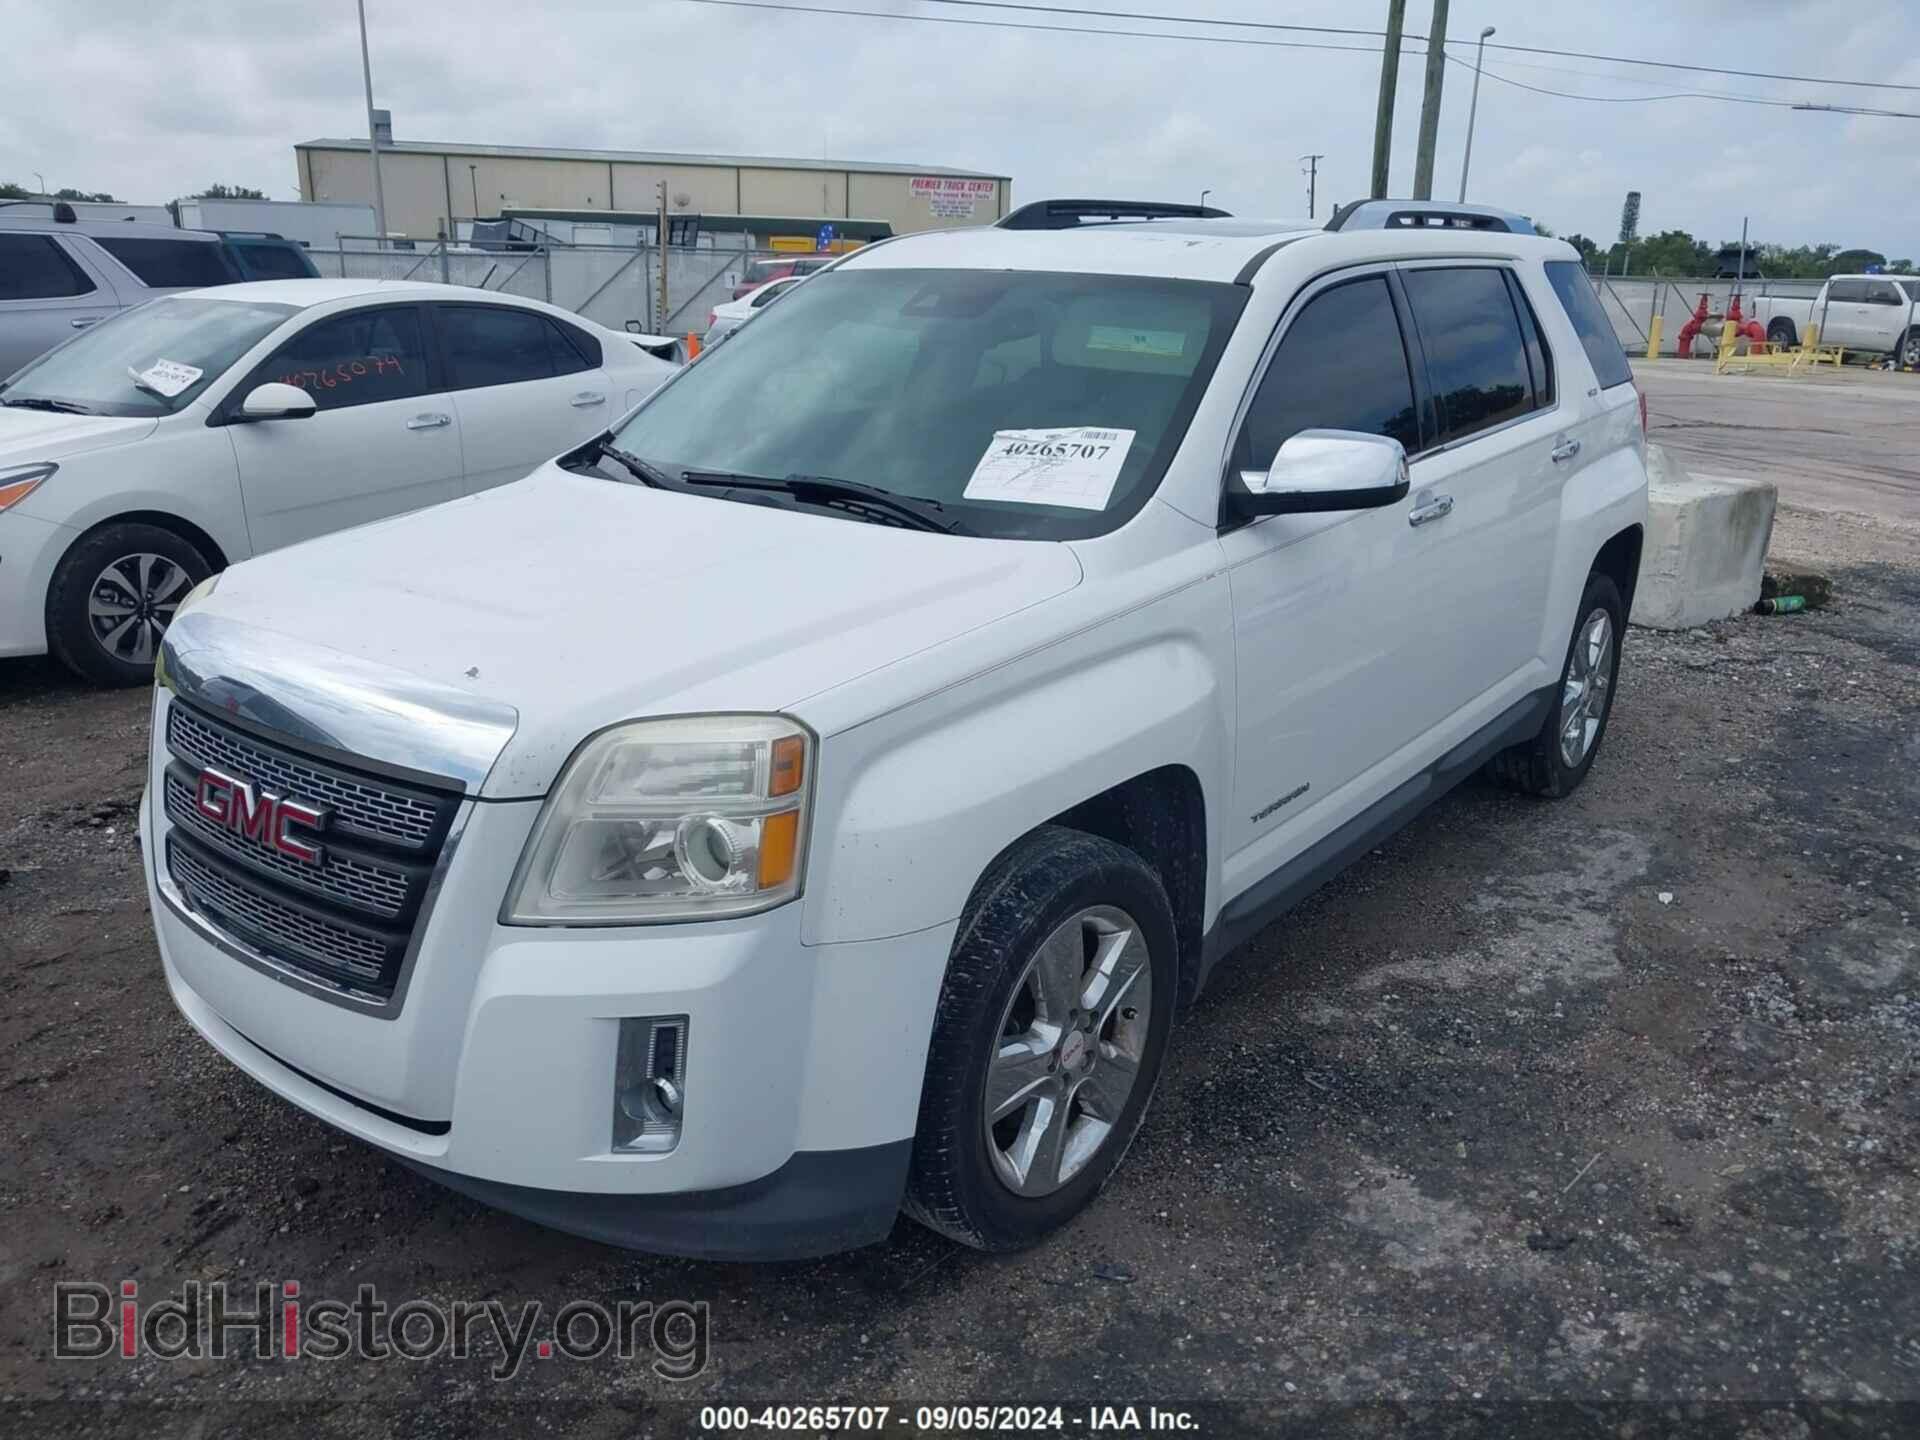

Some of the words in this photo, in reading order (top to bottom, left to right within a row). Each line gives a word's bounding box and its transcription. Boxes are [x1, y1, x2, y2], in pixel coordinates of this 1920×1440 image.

[911, 178, 942, 190] PREMIER
[943, 180, 966, 191] TRUCK
[967, 182, 994, 192] CENTER
[1000, 442, 1111, 461] 40265707
[197, 766, 326, 867] GMC
